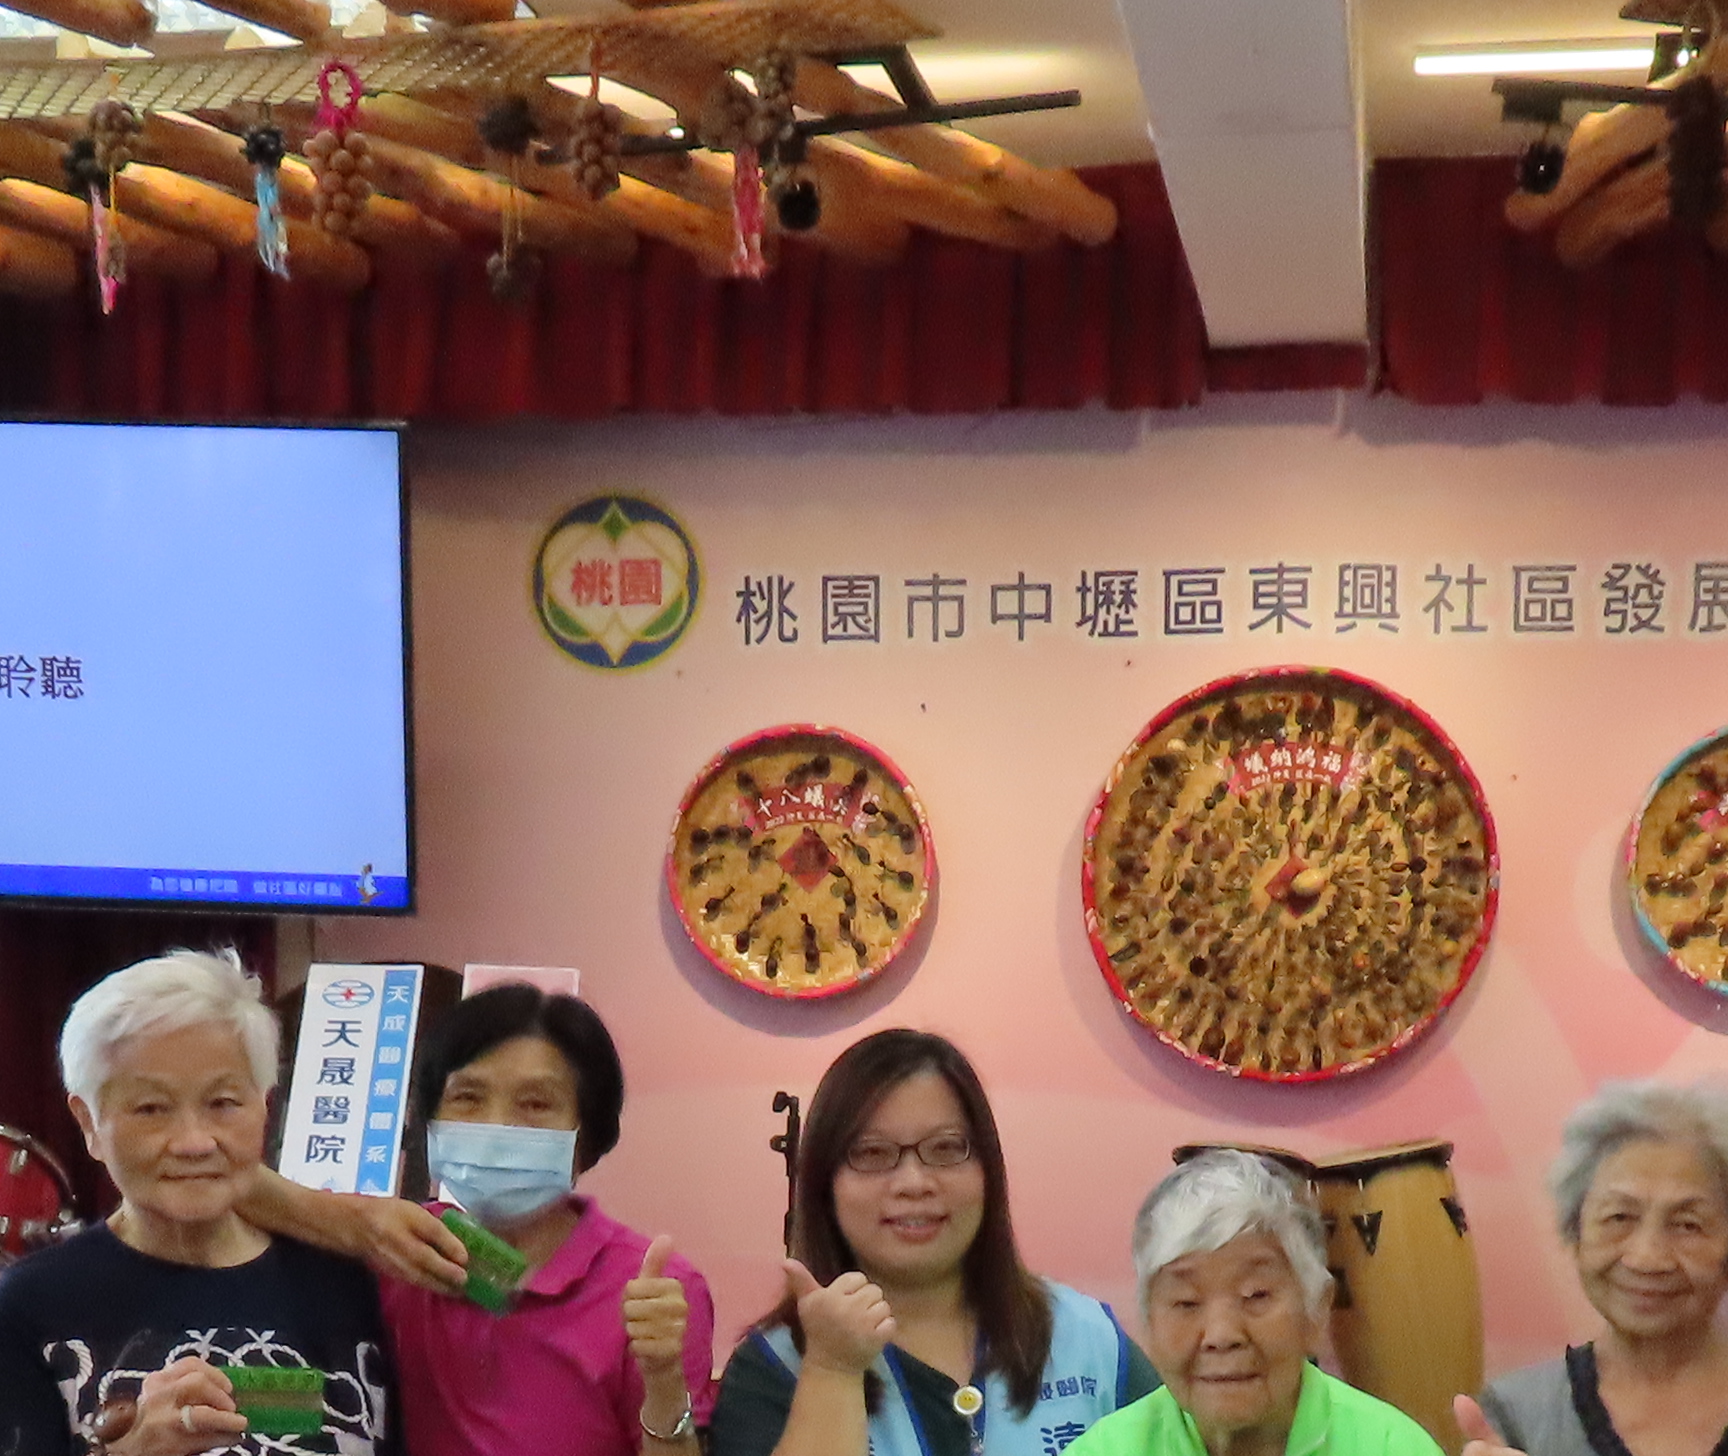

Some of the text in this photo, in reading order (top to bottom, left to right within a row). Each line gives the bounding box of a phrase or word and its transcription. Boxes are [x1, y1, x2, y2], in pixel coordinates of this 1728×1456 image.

[571, 558, 662, 606] 桃園
[304, 1020, 364, 1165] 天晟醫院
